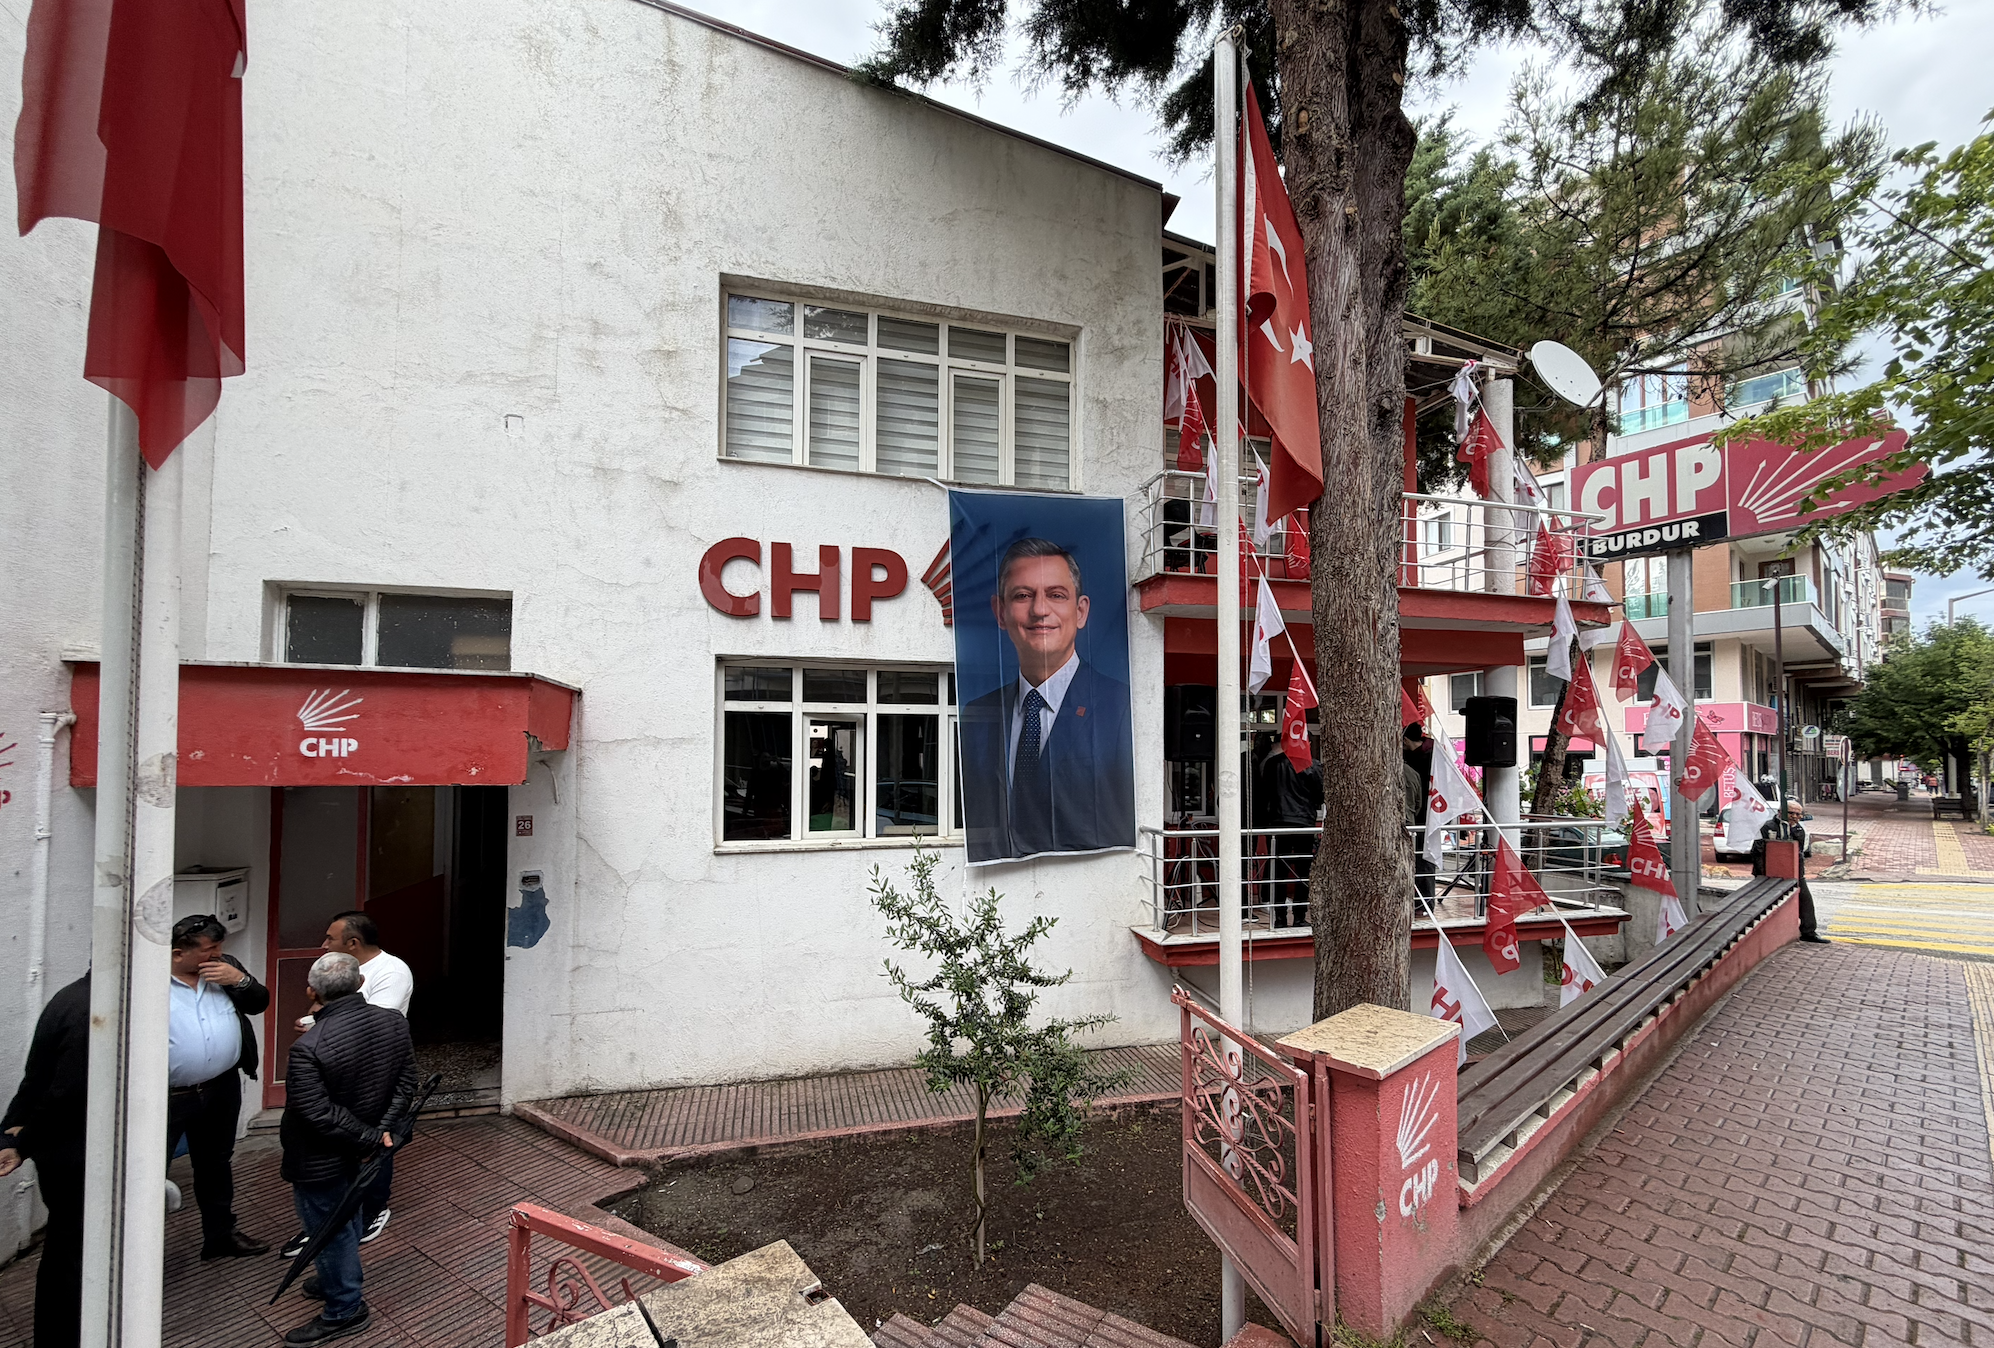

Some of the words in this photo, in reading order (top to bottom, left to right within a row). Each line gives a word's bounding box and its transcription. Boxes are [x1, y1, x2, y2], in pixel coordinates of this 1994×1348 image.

[1581, 443, 1722, 531] CHP
[1592, 521, 1701, 555] BURDUR
[698, 537, 908, 622] CHP
[299, 737, 359, 758] CHP
[517, 820, 532, 830] 26
[1399, 1158, 1439, 1217] CHP
